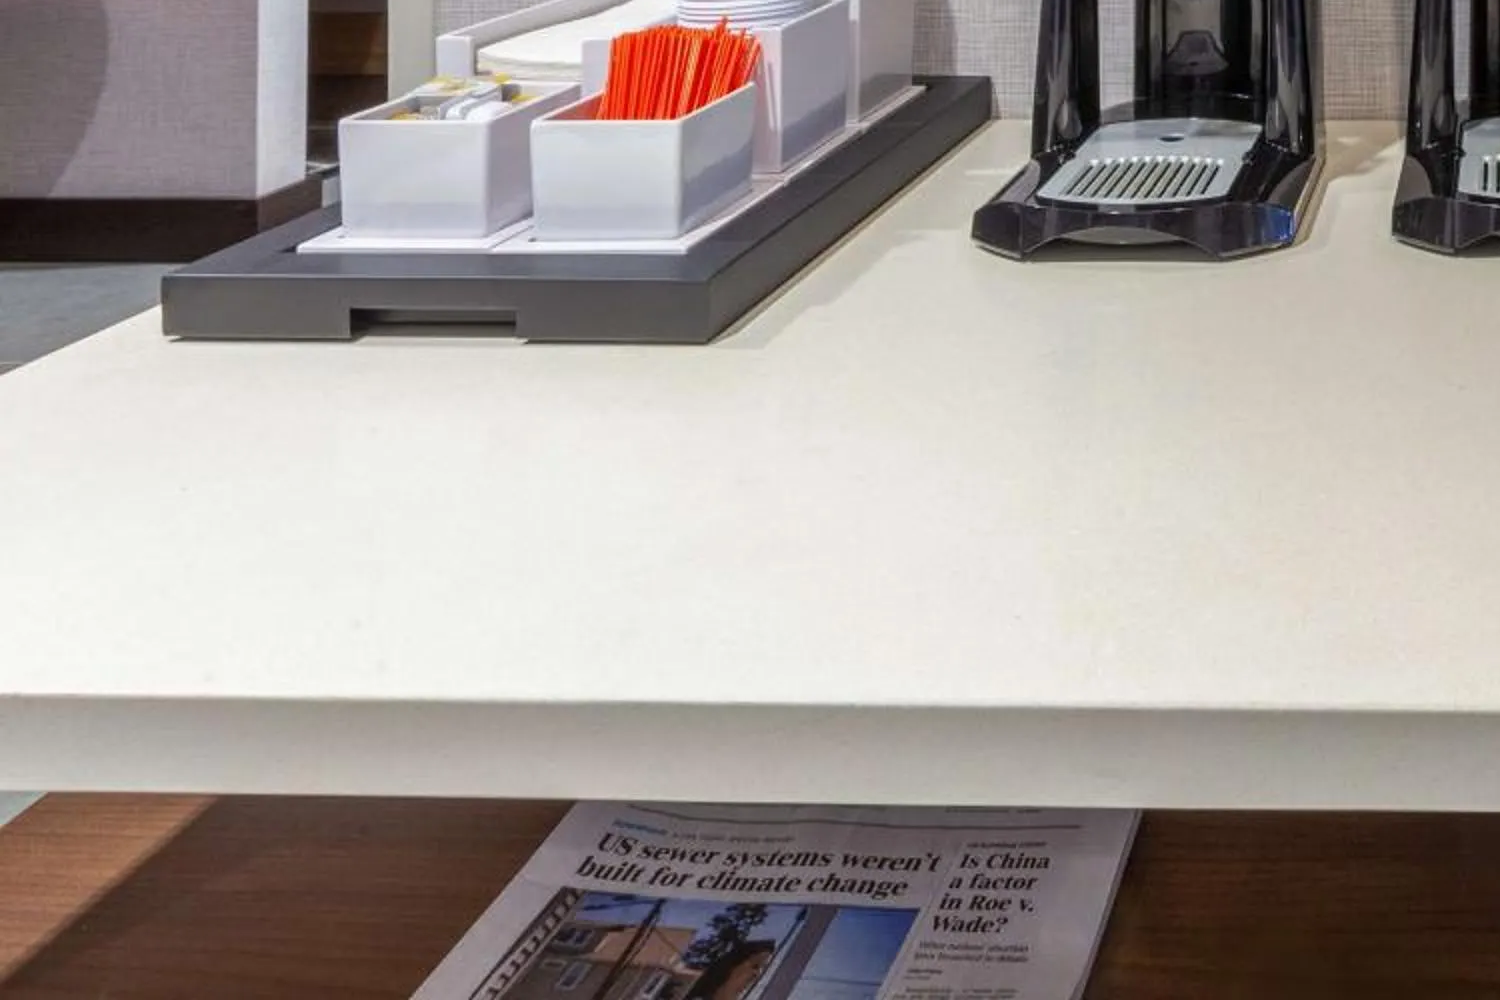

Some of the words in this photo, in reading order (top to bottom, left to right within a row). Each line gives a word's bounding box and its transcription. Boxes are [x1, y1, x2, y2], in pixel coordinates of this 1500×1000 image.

[597, 832, 638, 856] US
[638, 846, 720, 867] sewer
[725, 848, 832, 871] systems
[841, 851, 942, 873] weren't
[960, 853, 978, 869] Is
[986, 852, 1051, 869] China
[576, 855, 645, 882] built
[648, 865, 694, 889] for
[697, 866, 801, 893] climate
[806, 873, 908, 899] change
[949, 877, 963, 890] a
[968, 873, 1038, 890] factor
[939, 893, 963, 911] in
[967, 895, 1012, 911] Roe
[1018, 901, 1035, 913] v.
[932, 915, 1009, 934] Wade?
